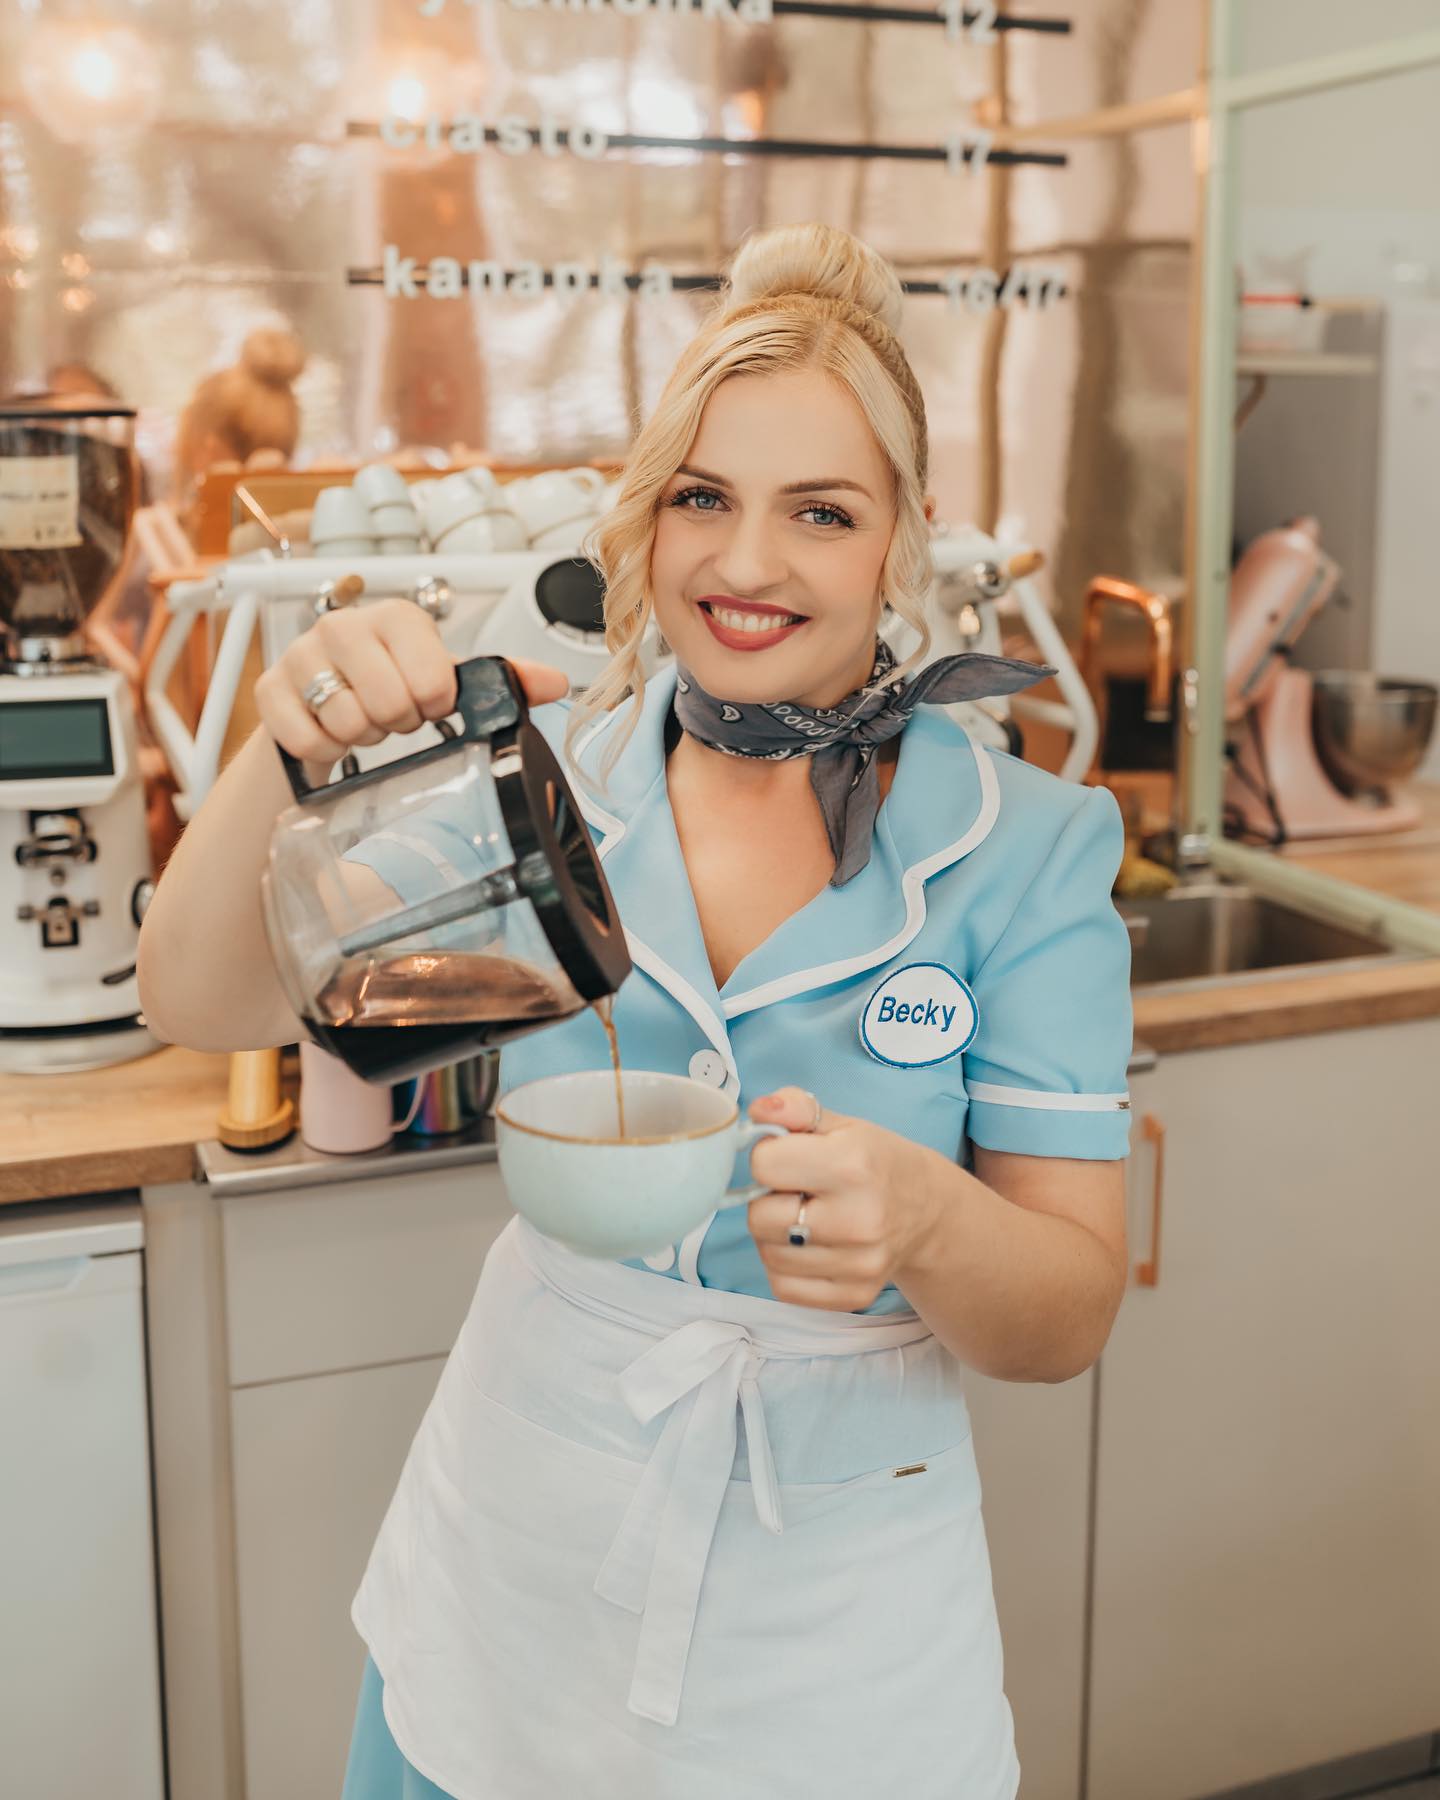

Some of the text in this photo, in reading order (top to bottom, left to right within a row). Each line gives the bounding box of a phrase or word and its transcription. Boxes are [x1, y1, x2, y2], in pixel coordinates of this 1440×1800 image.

[937, 0, 998, 43] 12
[380, 108, 993, 175] ciasto 17
[877, 996, 957, 1032] Becky
